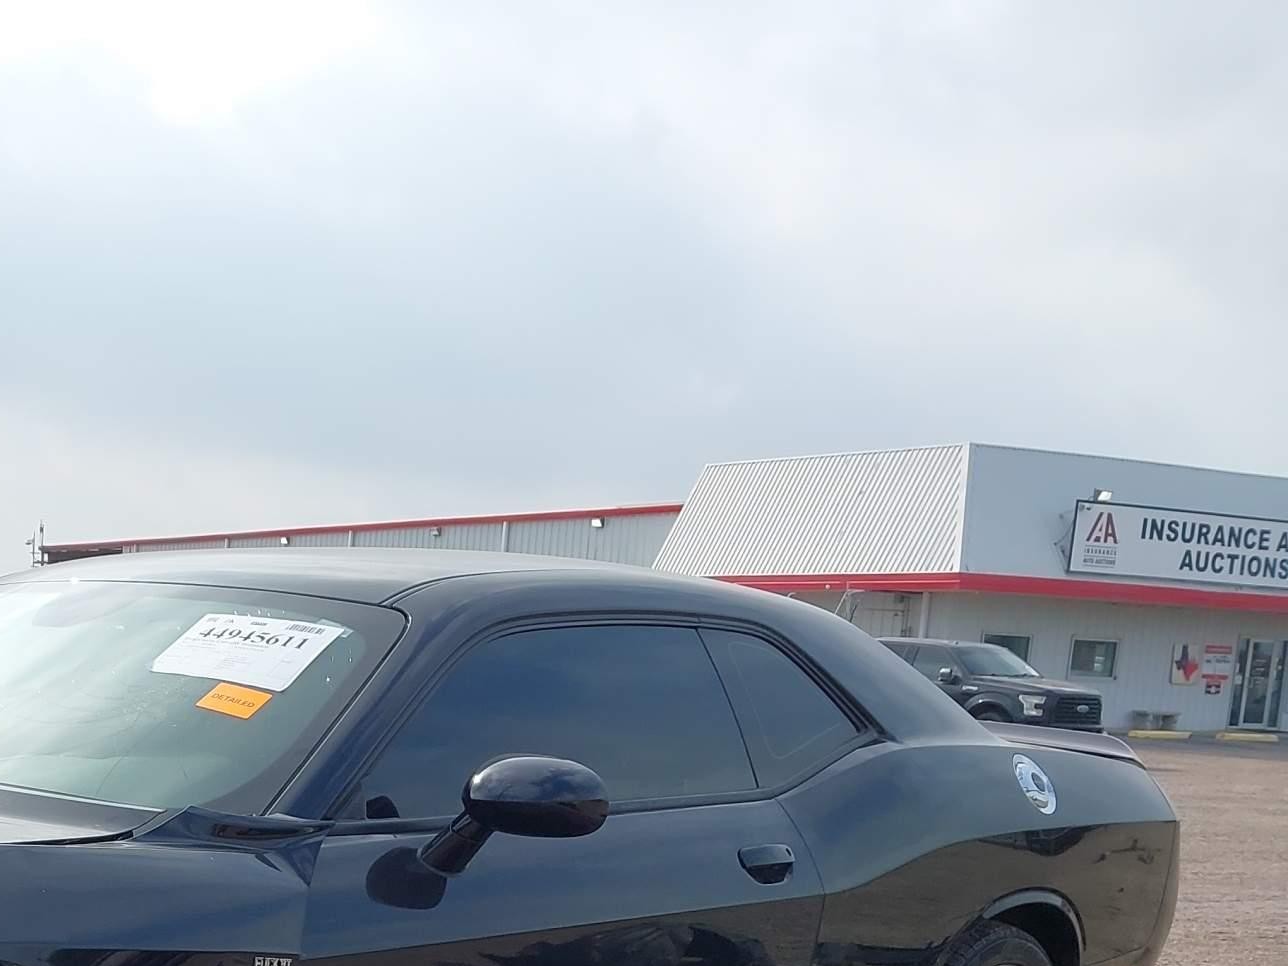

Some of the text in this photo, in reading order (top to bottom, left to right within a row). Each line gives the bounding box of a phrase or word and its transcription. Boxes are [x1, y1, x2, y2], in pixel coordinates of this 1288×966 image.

[1140, 517, 1271, 551] INSURANCE
[1179, 549, 1288, 579] AUCTIONS
[199, 626, 310, 649] 44945611
[211, 692, 256, 709] DETAILED
